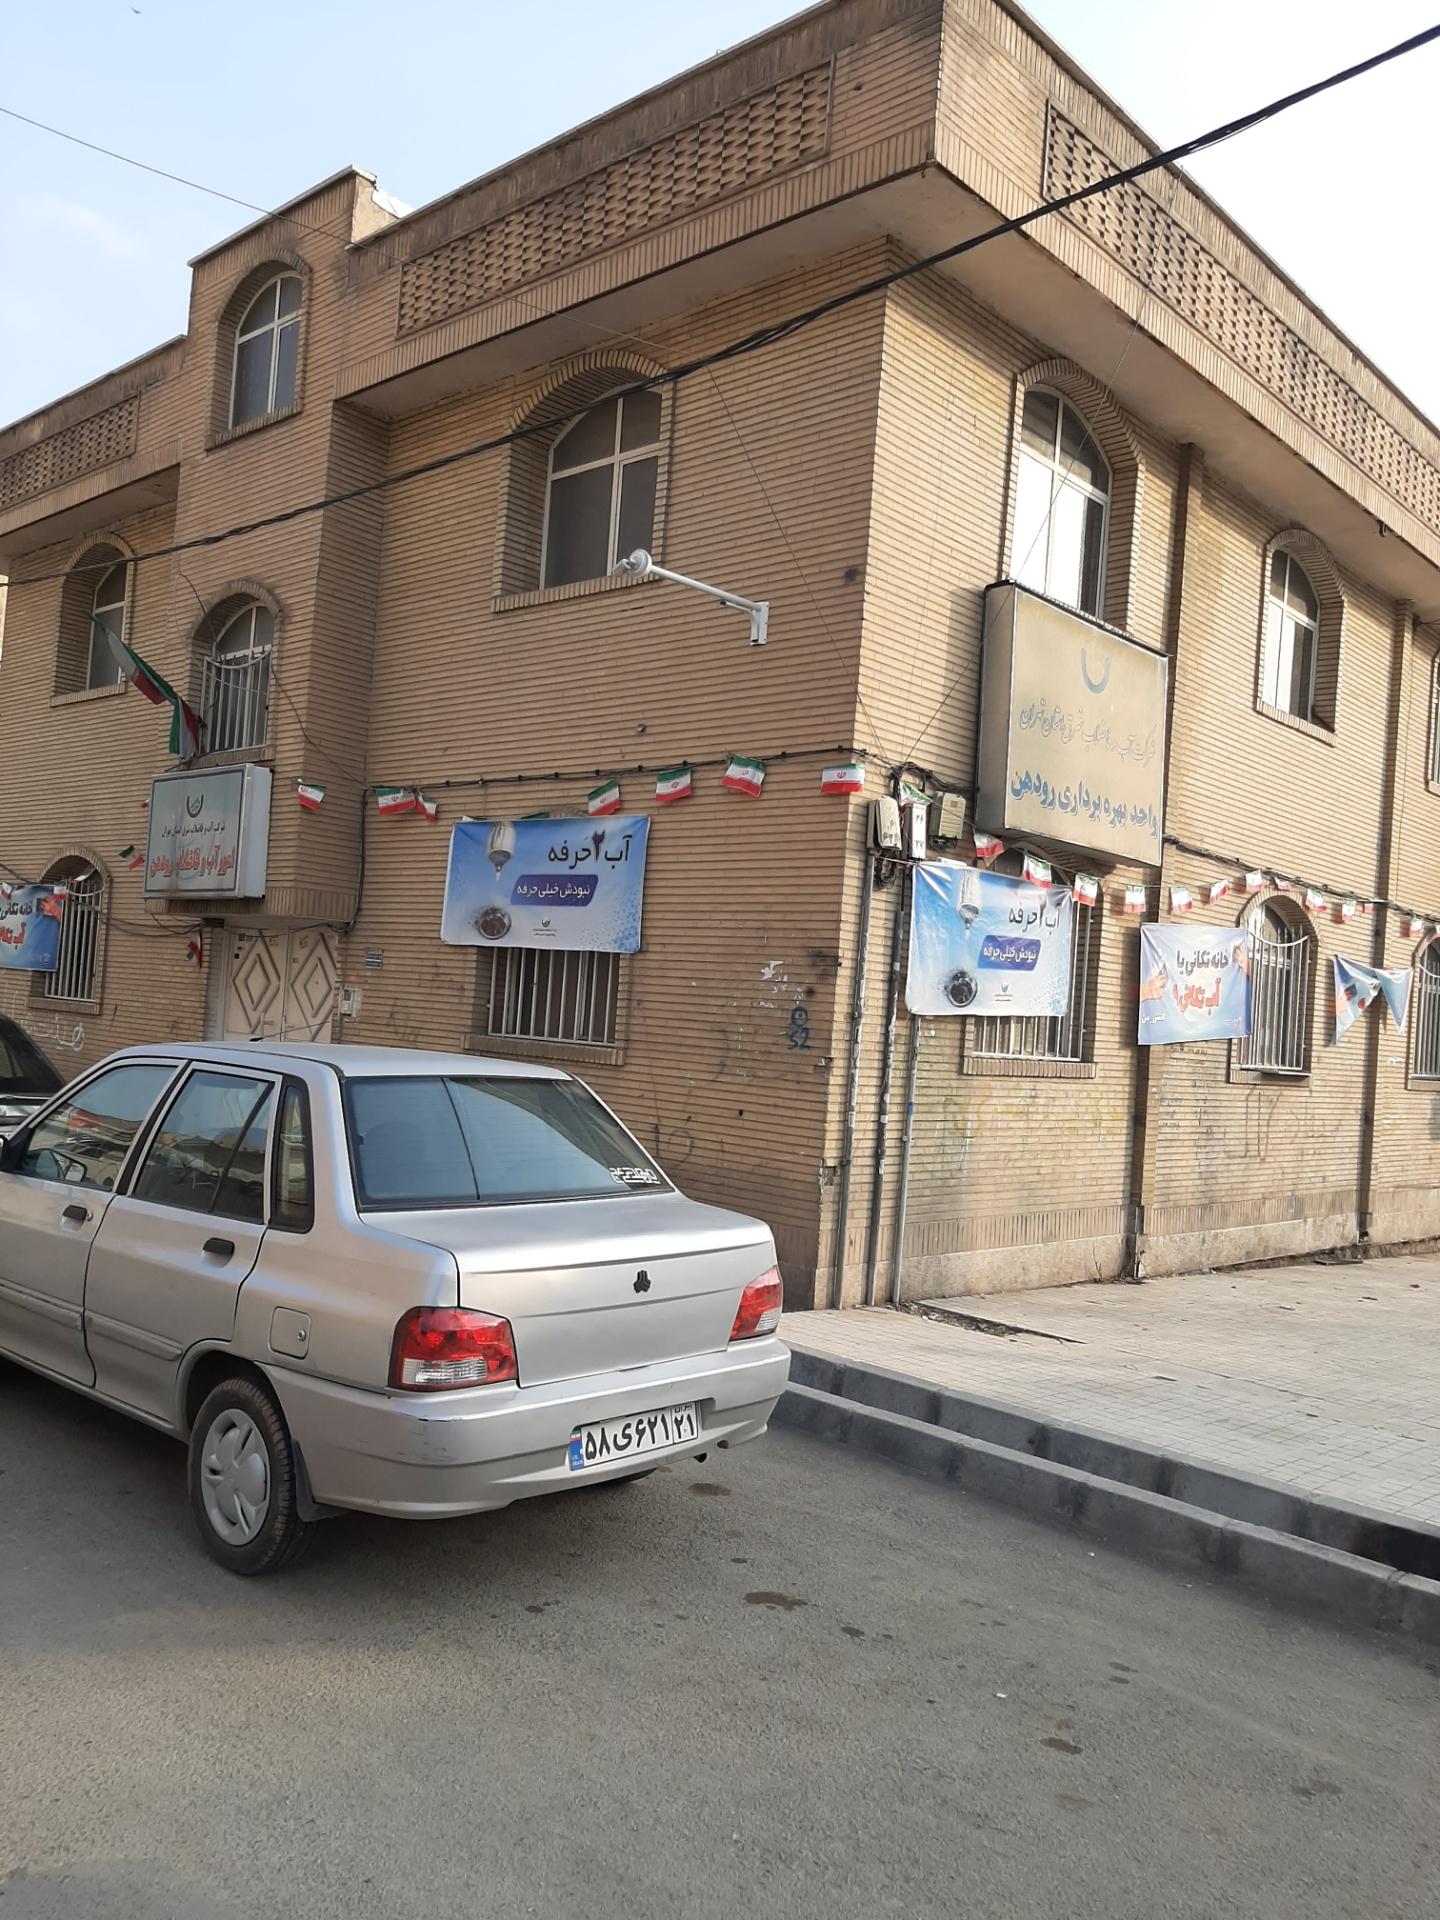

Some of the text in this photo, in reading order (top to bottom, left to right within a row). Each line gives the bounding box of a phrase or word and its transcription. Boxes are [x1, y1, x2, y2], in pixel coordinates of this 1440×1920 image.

[1011, 769, 1158, 839] واحد بهره برداری رودهن
[206, 844, 221, 876] آب
[604, 834, 633, 870] آب
[517, 882, 591, 899] نبودش خیلی حرفه
[19, 900, 33, 916] خانه
[1045, 902, 1063, 935] آب
[13, 921, 27, 951] آب
[983, 943, 1037, 963] نبودش خیلی حرفه
[1185, 949, 1211, 977] تکانی
[1211, 948, 1229, 969] خانه
[1205, 976, 1222, 1016] آب
